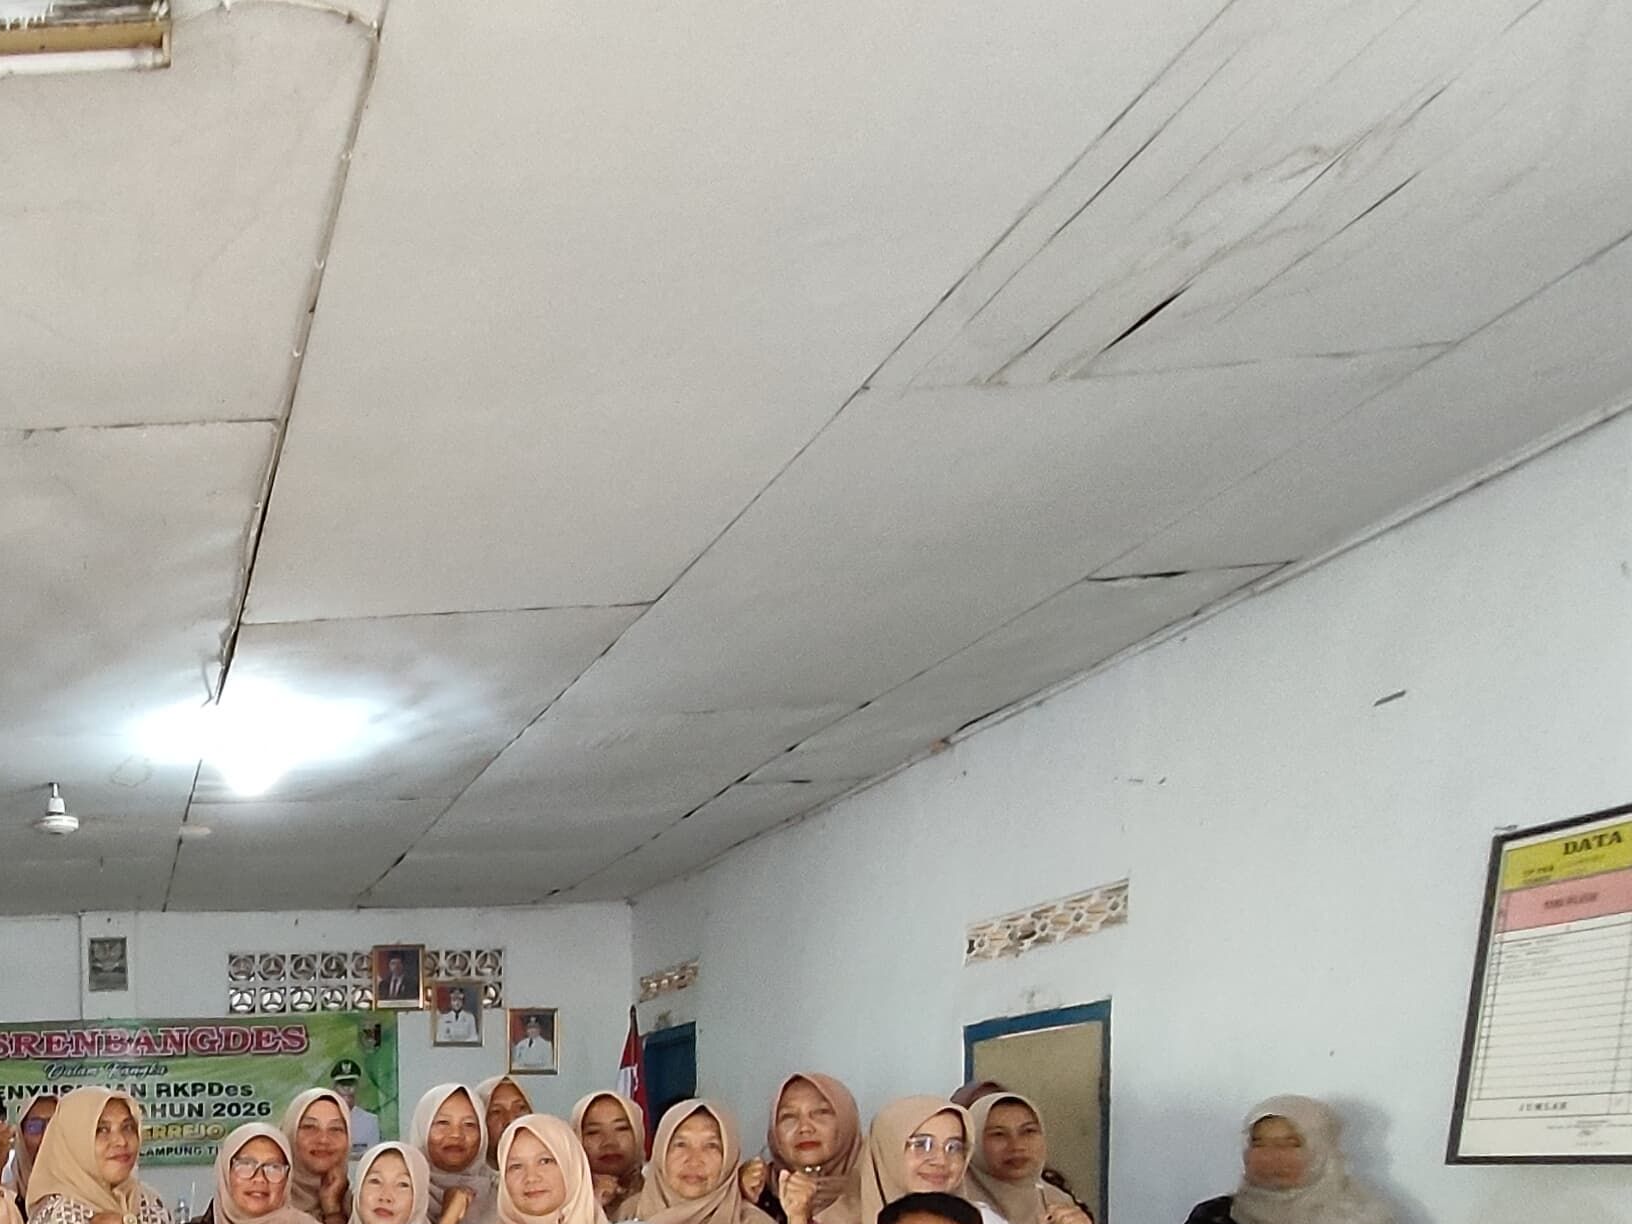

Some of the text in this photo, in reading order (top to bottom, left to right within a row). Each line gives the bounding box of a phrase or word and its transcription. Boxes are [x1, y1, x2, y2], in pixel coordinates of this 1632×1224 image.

[1563, 831, 1622, 855] DATA
[156, 1082, 253, 1098] RKPDes
[139, 1101, 271, 1118] AHUN 2026
[141, 1123, 226, 1141] ERREJO
